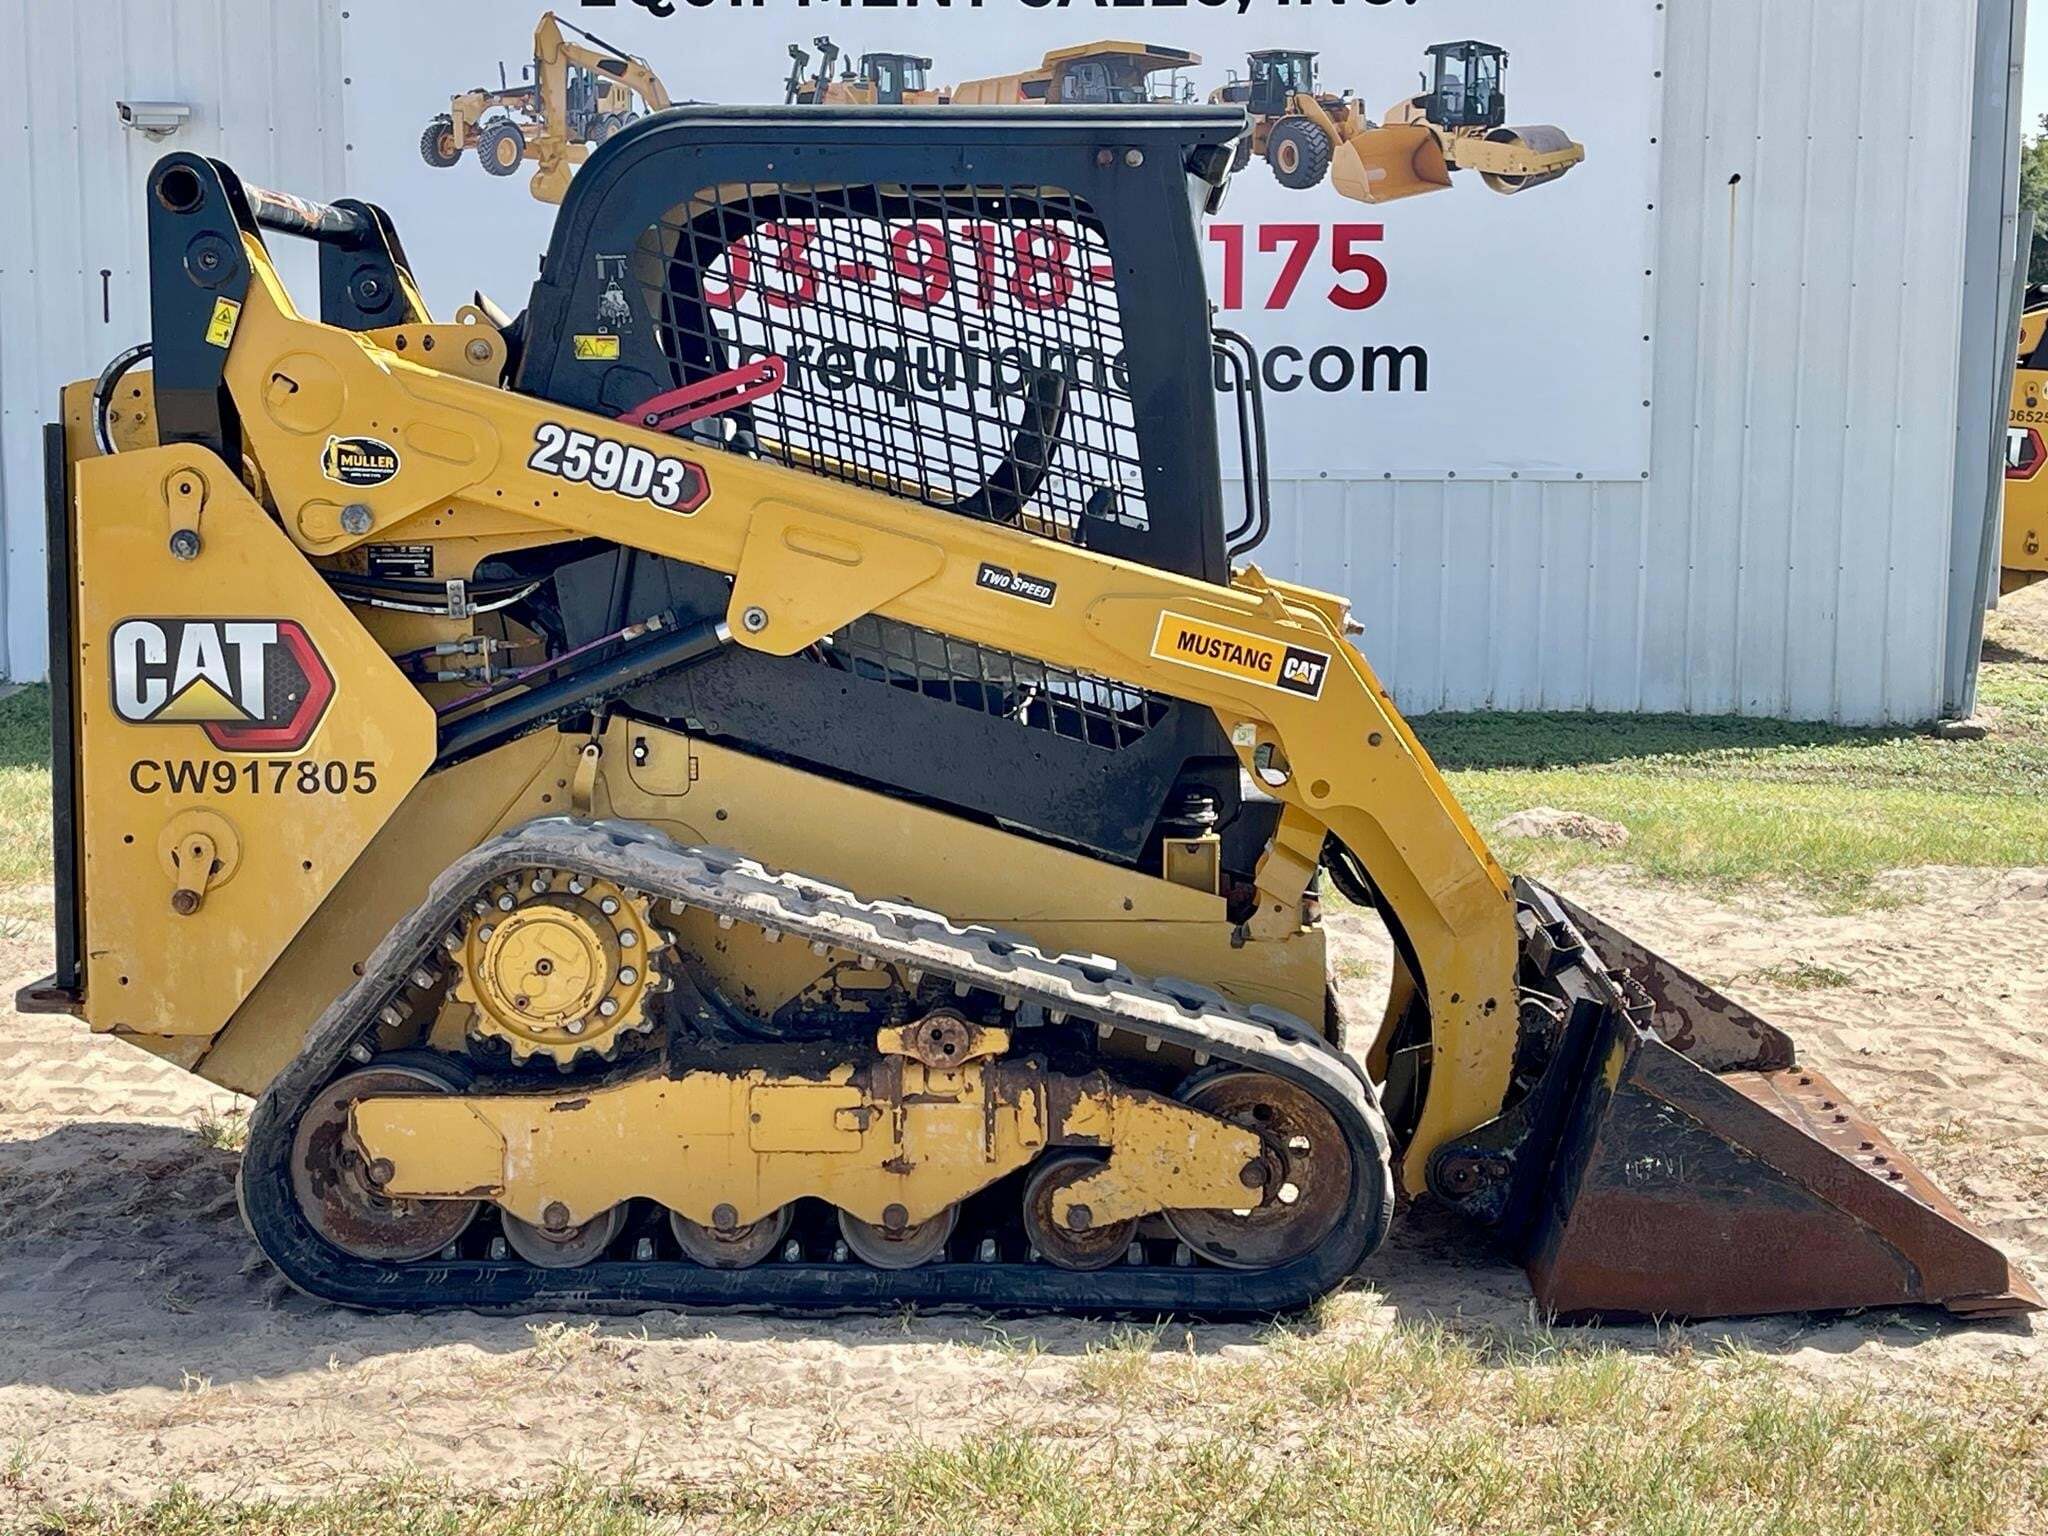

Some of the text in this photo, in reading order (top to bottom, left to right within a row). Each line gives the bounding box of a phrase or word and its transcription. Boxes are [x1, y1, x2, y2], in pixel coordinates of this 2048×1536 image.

[341, 455, 394, 468] MULLER
[530, 424, 685, 505] 259D3
[982, 568, 1051, 598] TWO SPEED
[1177, 630, 1273, 672] MUSTANG
[114, 621, 278, 720] CAT
[1283, 657, 1321, 685] CAT
[130, 760, 377, 794] CW917805
